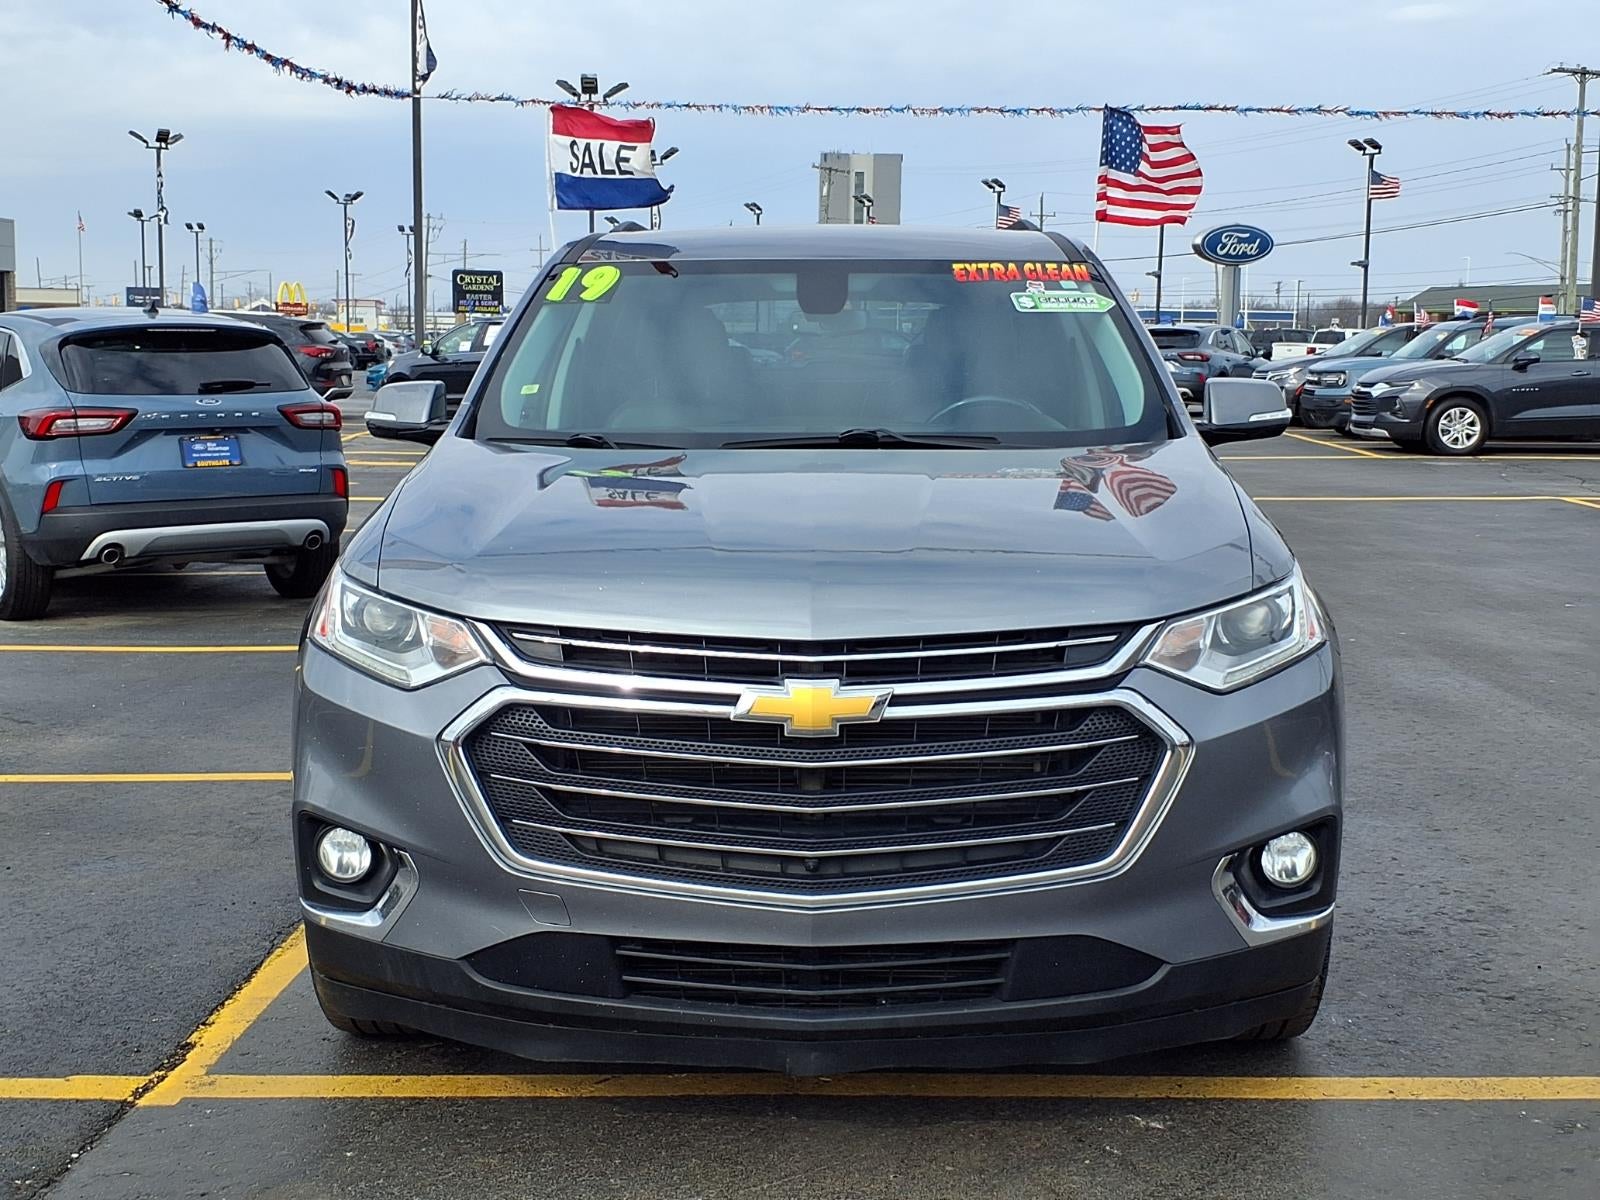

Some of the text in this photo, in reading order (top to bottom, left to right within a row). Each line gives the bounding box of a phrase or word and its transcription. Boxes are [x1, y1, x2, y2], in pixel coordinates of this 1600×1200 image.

[569, 139, 638, 176] SALE
[1216, 231, 1261, 256] Ford
[457, 274, 501, 286] CRYSTAL
[952, 262, 1092, 282] EXTRA CLEAN
[545, 265, 621, 302] 19
[466, 293, 493, 301] EASTER
